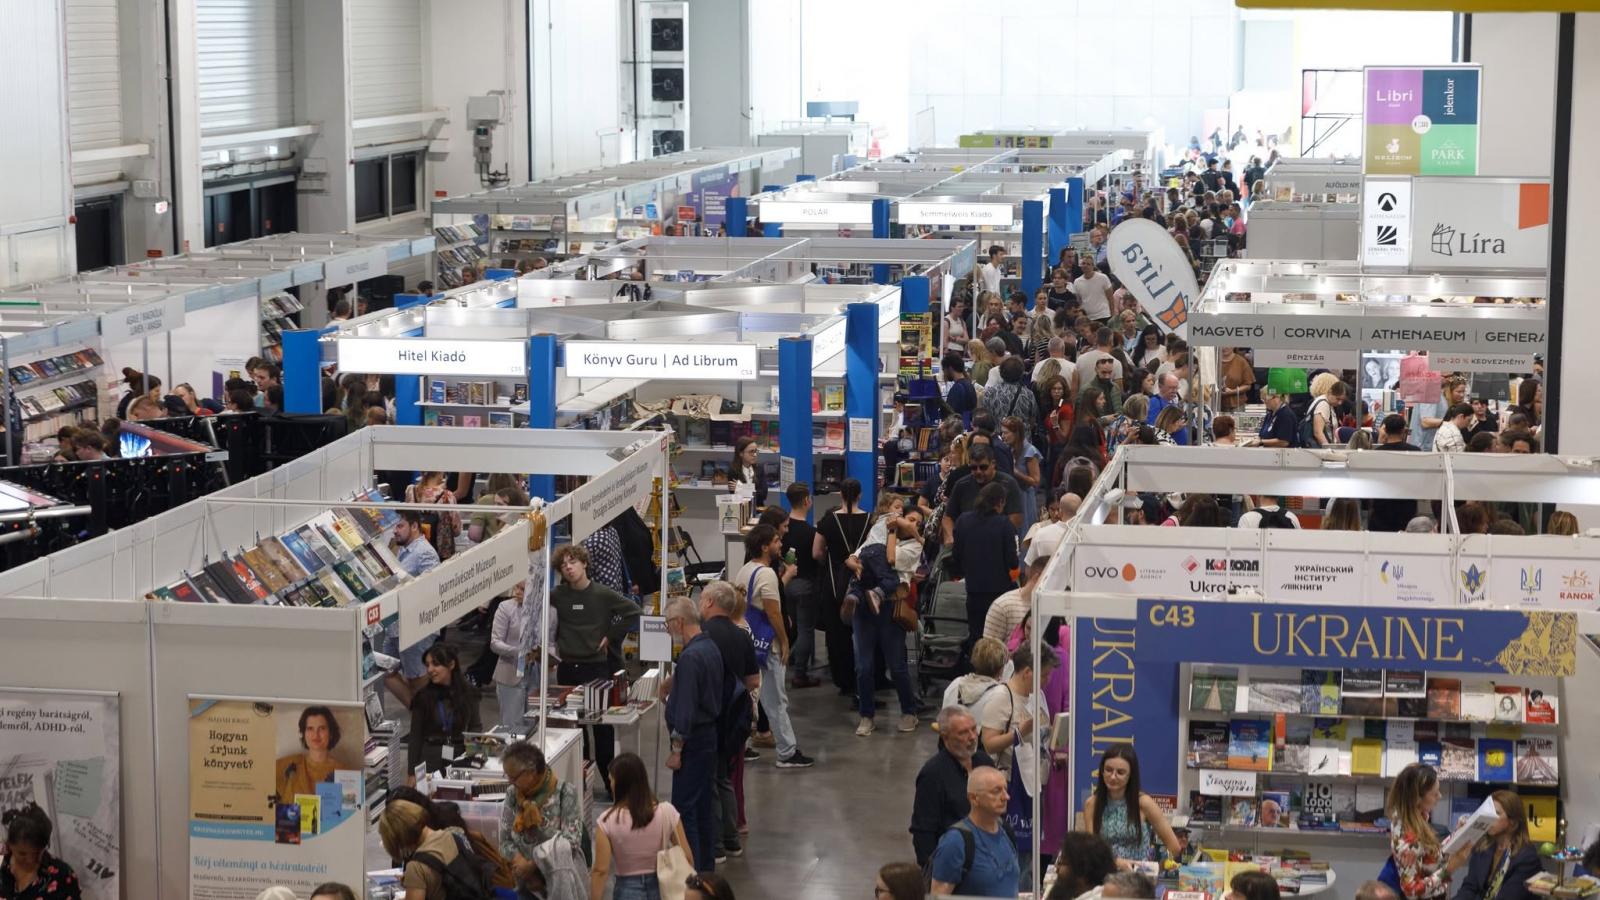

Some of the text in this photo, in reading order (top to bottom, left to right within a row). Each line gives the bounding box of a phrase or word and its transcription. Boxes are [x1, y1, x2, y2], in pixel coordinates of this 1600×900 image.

[1376, 90, 1413, 102] Libri
[1443, 78, 1457, 116] jelenkor
[1431, 149, 1465, 160] PARK
[1459, 232, 1506, 254] Líra
[1192, 325, 1265, 338] MAGVETŐ
[1284, 327, 1352, 339] CORVINA
[1371, 329, 1466, 341] ATHENAEUM
[398, 350, 467, 363] Hitel Kiadó
[583, 353, 623, 368] Könyv
[626, 354, 658, 366] Guru
[672, 354, 690, 367] Ad
[693, 355, 739, 367] Librum
[1286, 353, 1325, 361] PÉNZTÁR
[1084, 566, 1119, 578] OVO
[1294, 564, 1354, 574] УКРАЇНСЬКИЙ
[438, 555, 497, 598] Iparművészeti Múzeum
[419, 563, 514, 625] Magyar Természettudományi Múzeum
[1559, 592, 1594, 601] RANOK
[1149, 604, 1195, 627] C43
[1250, 612, 1465, 662] UKRAINE
[7, 708, 37, 720] regény
[39, 708, 93, 721] barátságról,
[34, 721, 86, 733] ADHD-ról.
[208, 730, 249, 742] Hogyan
[209, 744, 248, 756] írjunk
[203, 758, 254, 771] könyvet?
[193, 856, 328, 874] Kérj véleményt a kéziratodról!
